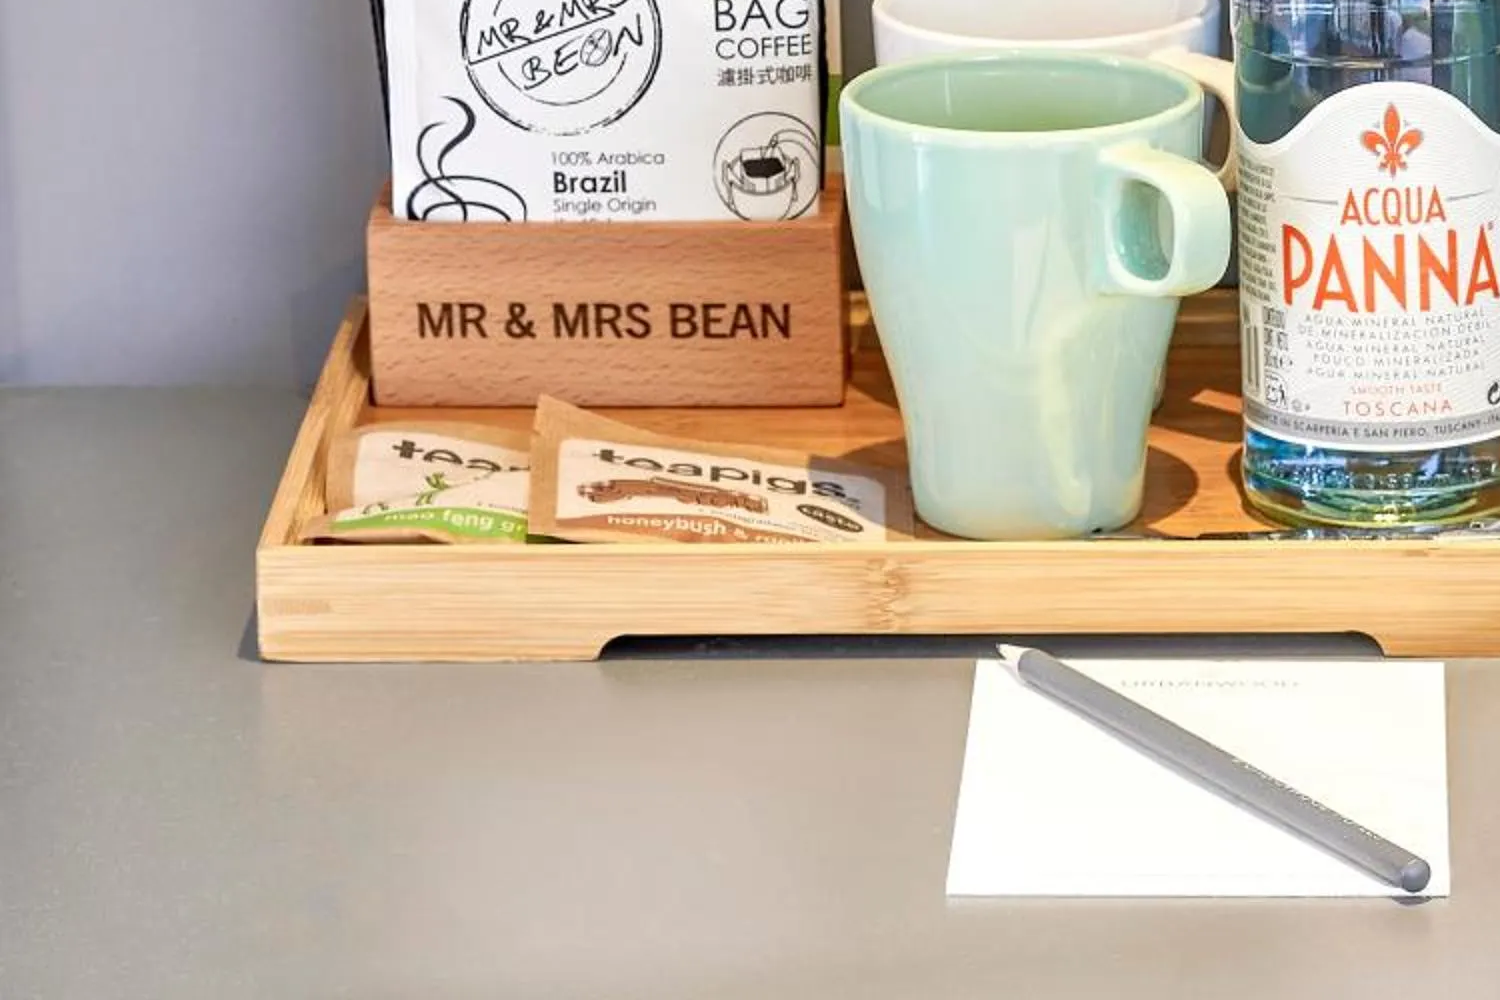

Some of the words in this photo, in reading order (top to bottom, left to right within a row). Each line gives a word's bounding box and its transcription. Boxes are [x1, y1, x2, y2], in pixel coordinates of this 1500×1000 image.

[477, 18, 534, 56] MR
[715, 33, 812, 60] COFFEE
[551, 151, 592, 165] 100%
[597, 151, 666, 165] Arabica
[553, 170, 627, 193] Brazil
[553, 197, 602, 215] Single
[607, 197, 657, 215] Origin
[1340, 185, 1447, 226] ACQUA
[1281, 222, 1500, 313] PANNA
[417, 303, 488, 339] MR
[504, 303, 535, 339] &
[553, 303, 651, 339] MRS
[670, 303, 791, 338] BEAN
[1305, 313, 1343, 326] AGUA
[1352, 316, 1417, 328] MINERAL
[1426, 310, 1486, 324] NATURAL
[1299, 325, 1314, 336] DE
[1306, 340, 1345, 353] AGUA
[1353, 343, 1418, 354] MINERAL
[1426, 335, 1486, 351] NATURAL
[1313, 353, 1366, 366] POUCO
[1374, 349, 1480, 367] MINERALIZADA
[1307, 367, 1345, 379] AGUA
[1354, 370, 1418, 380] MINERAL
[1426, 363, 1486, 377] NATURAL
[1350, 384, 1405, 396] SMOOTH
[1343, 398, 1453, 417] TOSCANA
[1364, 427, 1389, 438] SAN
[592, 449, 847, 499] teapigs
[443, 508, 494, 531] feng
[606, 513, 728, 537] honeybush
